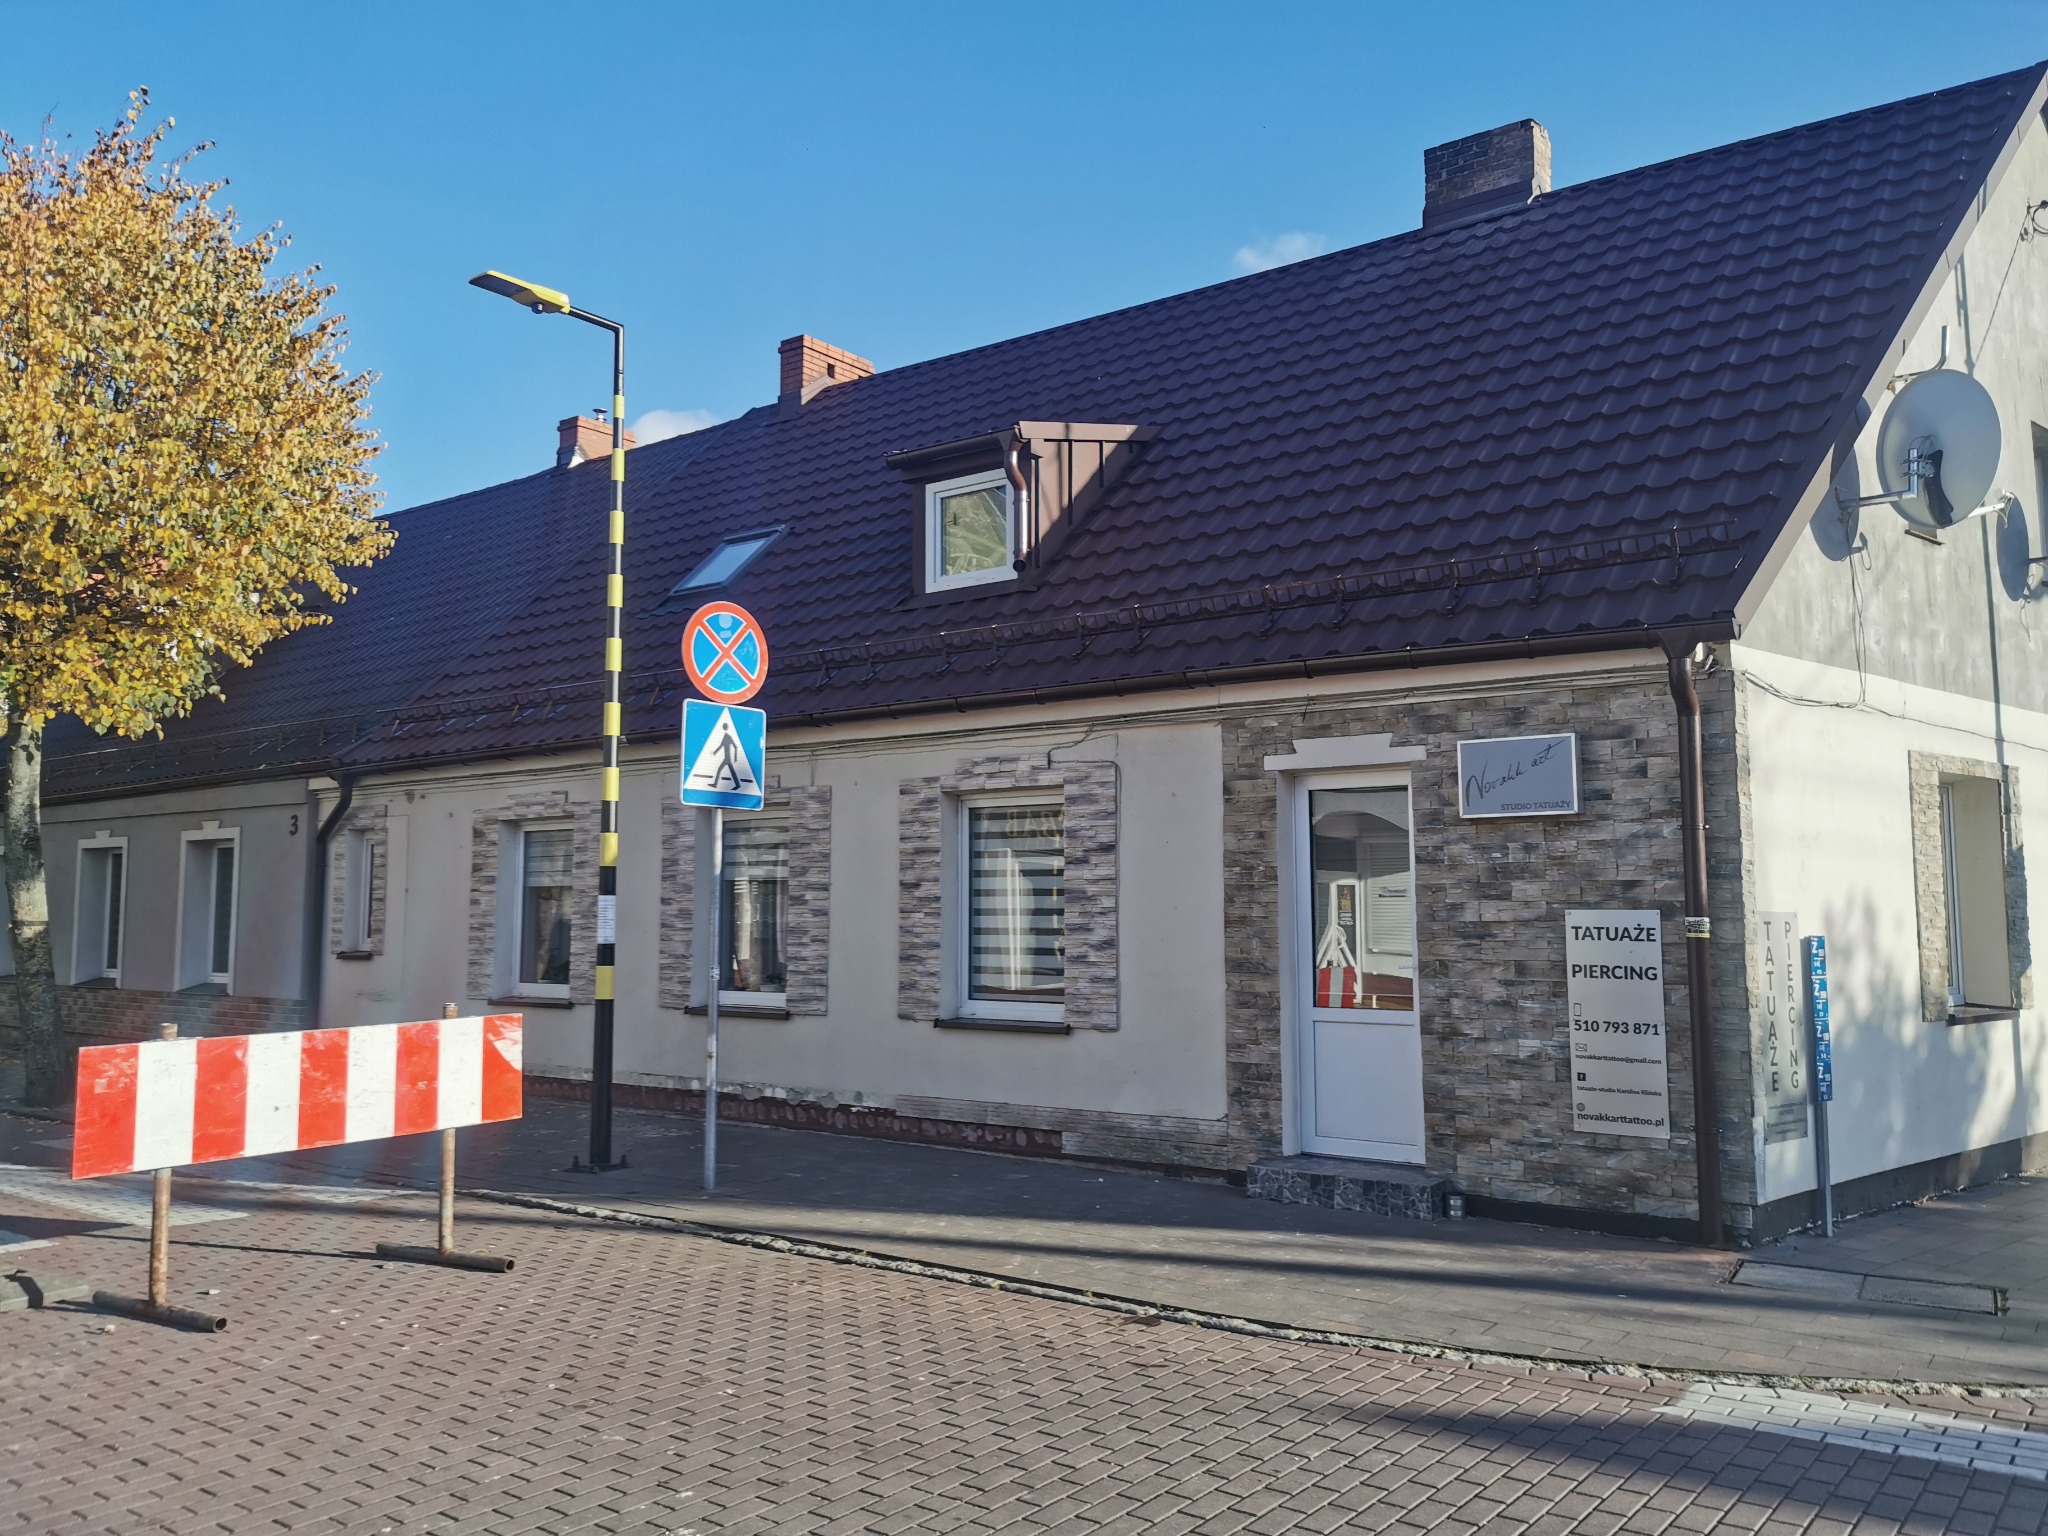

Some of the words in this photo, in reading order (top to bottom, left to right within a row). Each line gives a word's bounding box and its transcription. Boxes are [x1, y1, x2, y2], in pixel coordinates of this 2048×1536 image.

[1531, 739, 1566, 768] art
[1501, 802, 1533, 811] STUDIO
[1533, 800, 1571, 810] TATUAŻY
[289, 814, 299, 836] 3
[1571, 923, 1657, 942] TATUAŻE
[1571, 964, 1658, 981] PIERCING
[1763, 920, 1780, 1092] TATUAŻE
[1784, 920, 1799, 1089] PIERCING
[1574, 1019, 1600, 1032] 510
[1603, 1021, 1629, 1034] 793
[1633, 1022, 1661, 1036] 871
[1575, 1054, 1662, 1065] novakkarttattoo@gmail.com
[1577, 1113, 1665, 1127] novakkarttattoo.pl
